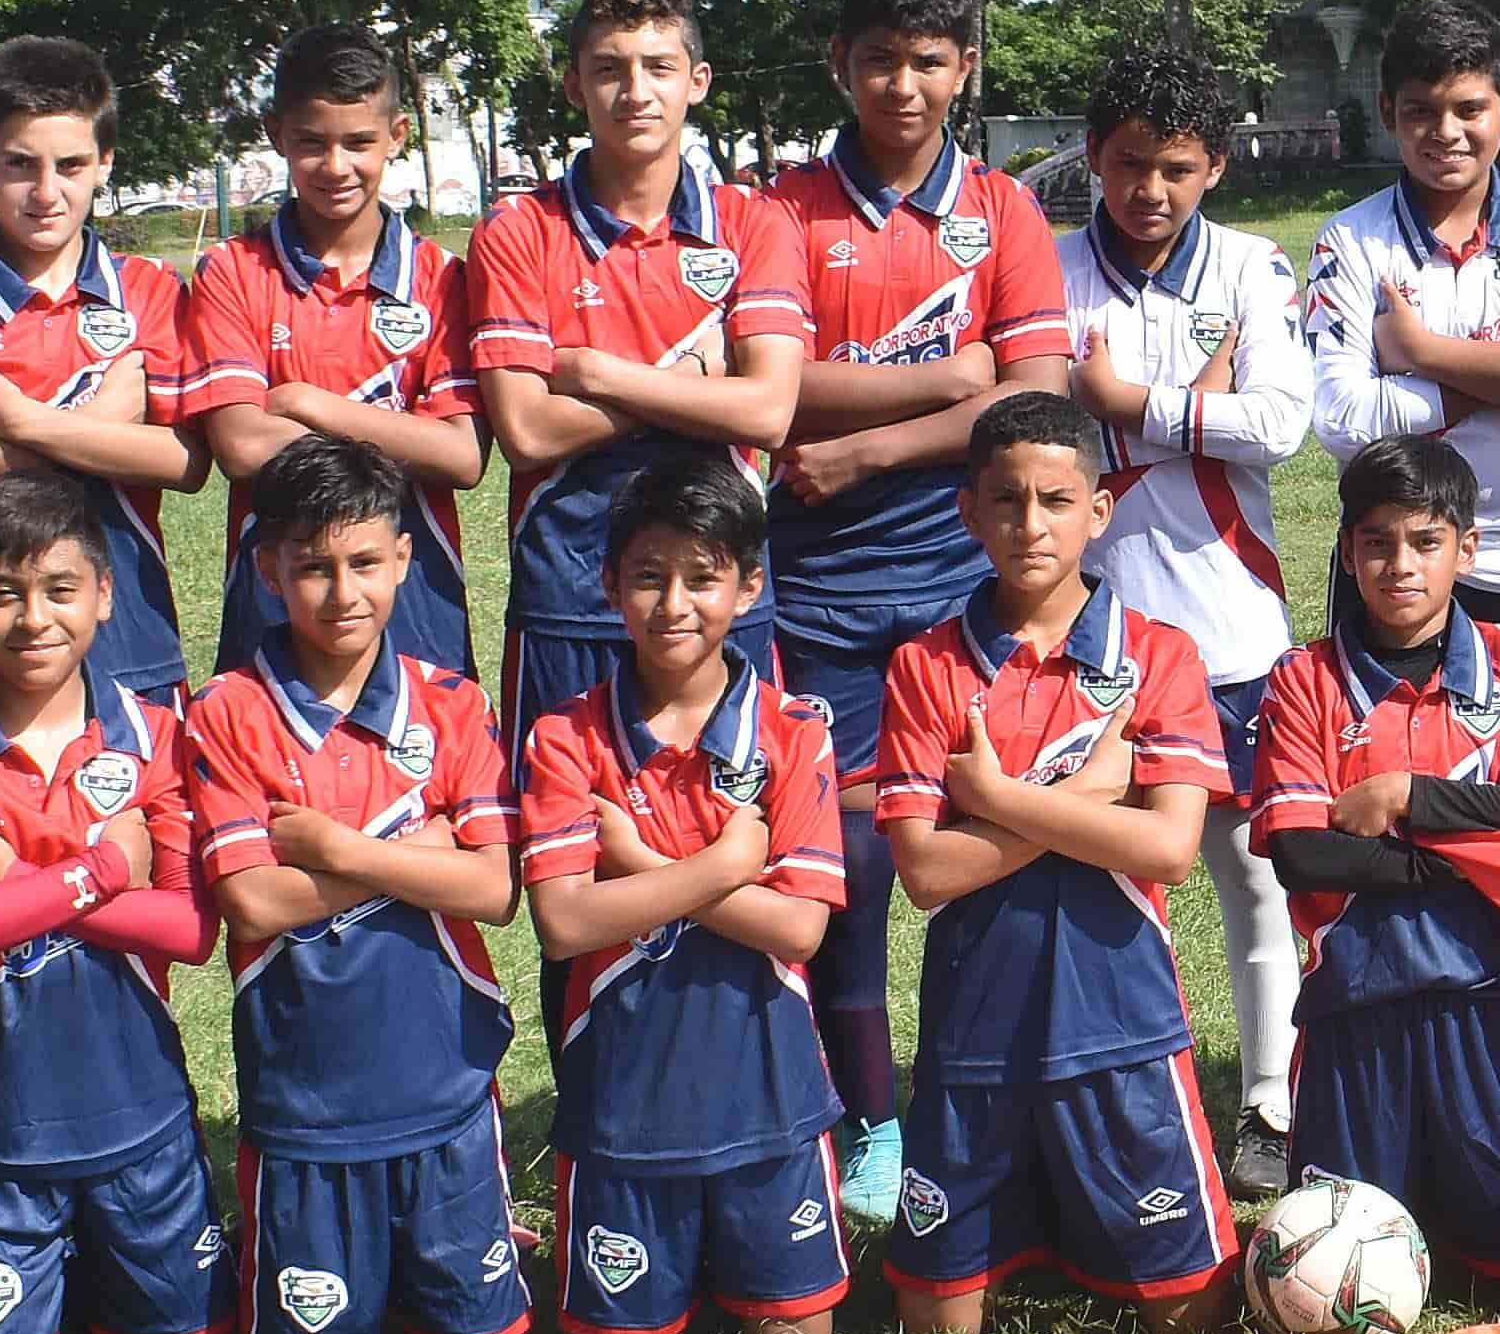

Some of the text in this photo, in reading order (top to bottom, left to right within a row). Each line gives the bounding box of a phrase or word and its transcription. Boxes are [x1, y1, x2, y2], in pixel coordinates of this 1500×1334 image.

[82, 776, 132, 790] LMF
[718, 768, 766, 787] LMF
[1139, 1207, 1188, 1226] UMBRO
[594, 1256, 638, 1269] LMF
[286, 1295, 337, 1307] LMF
